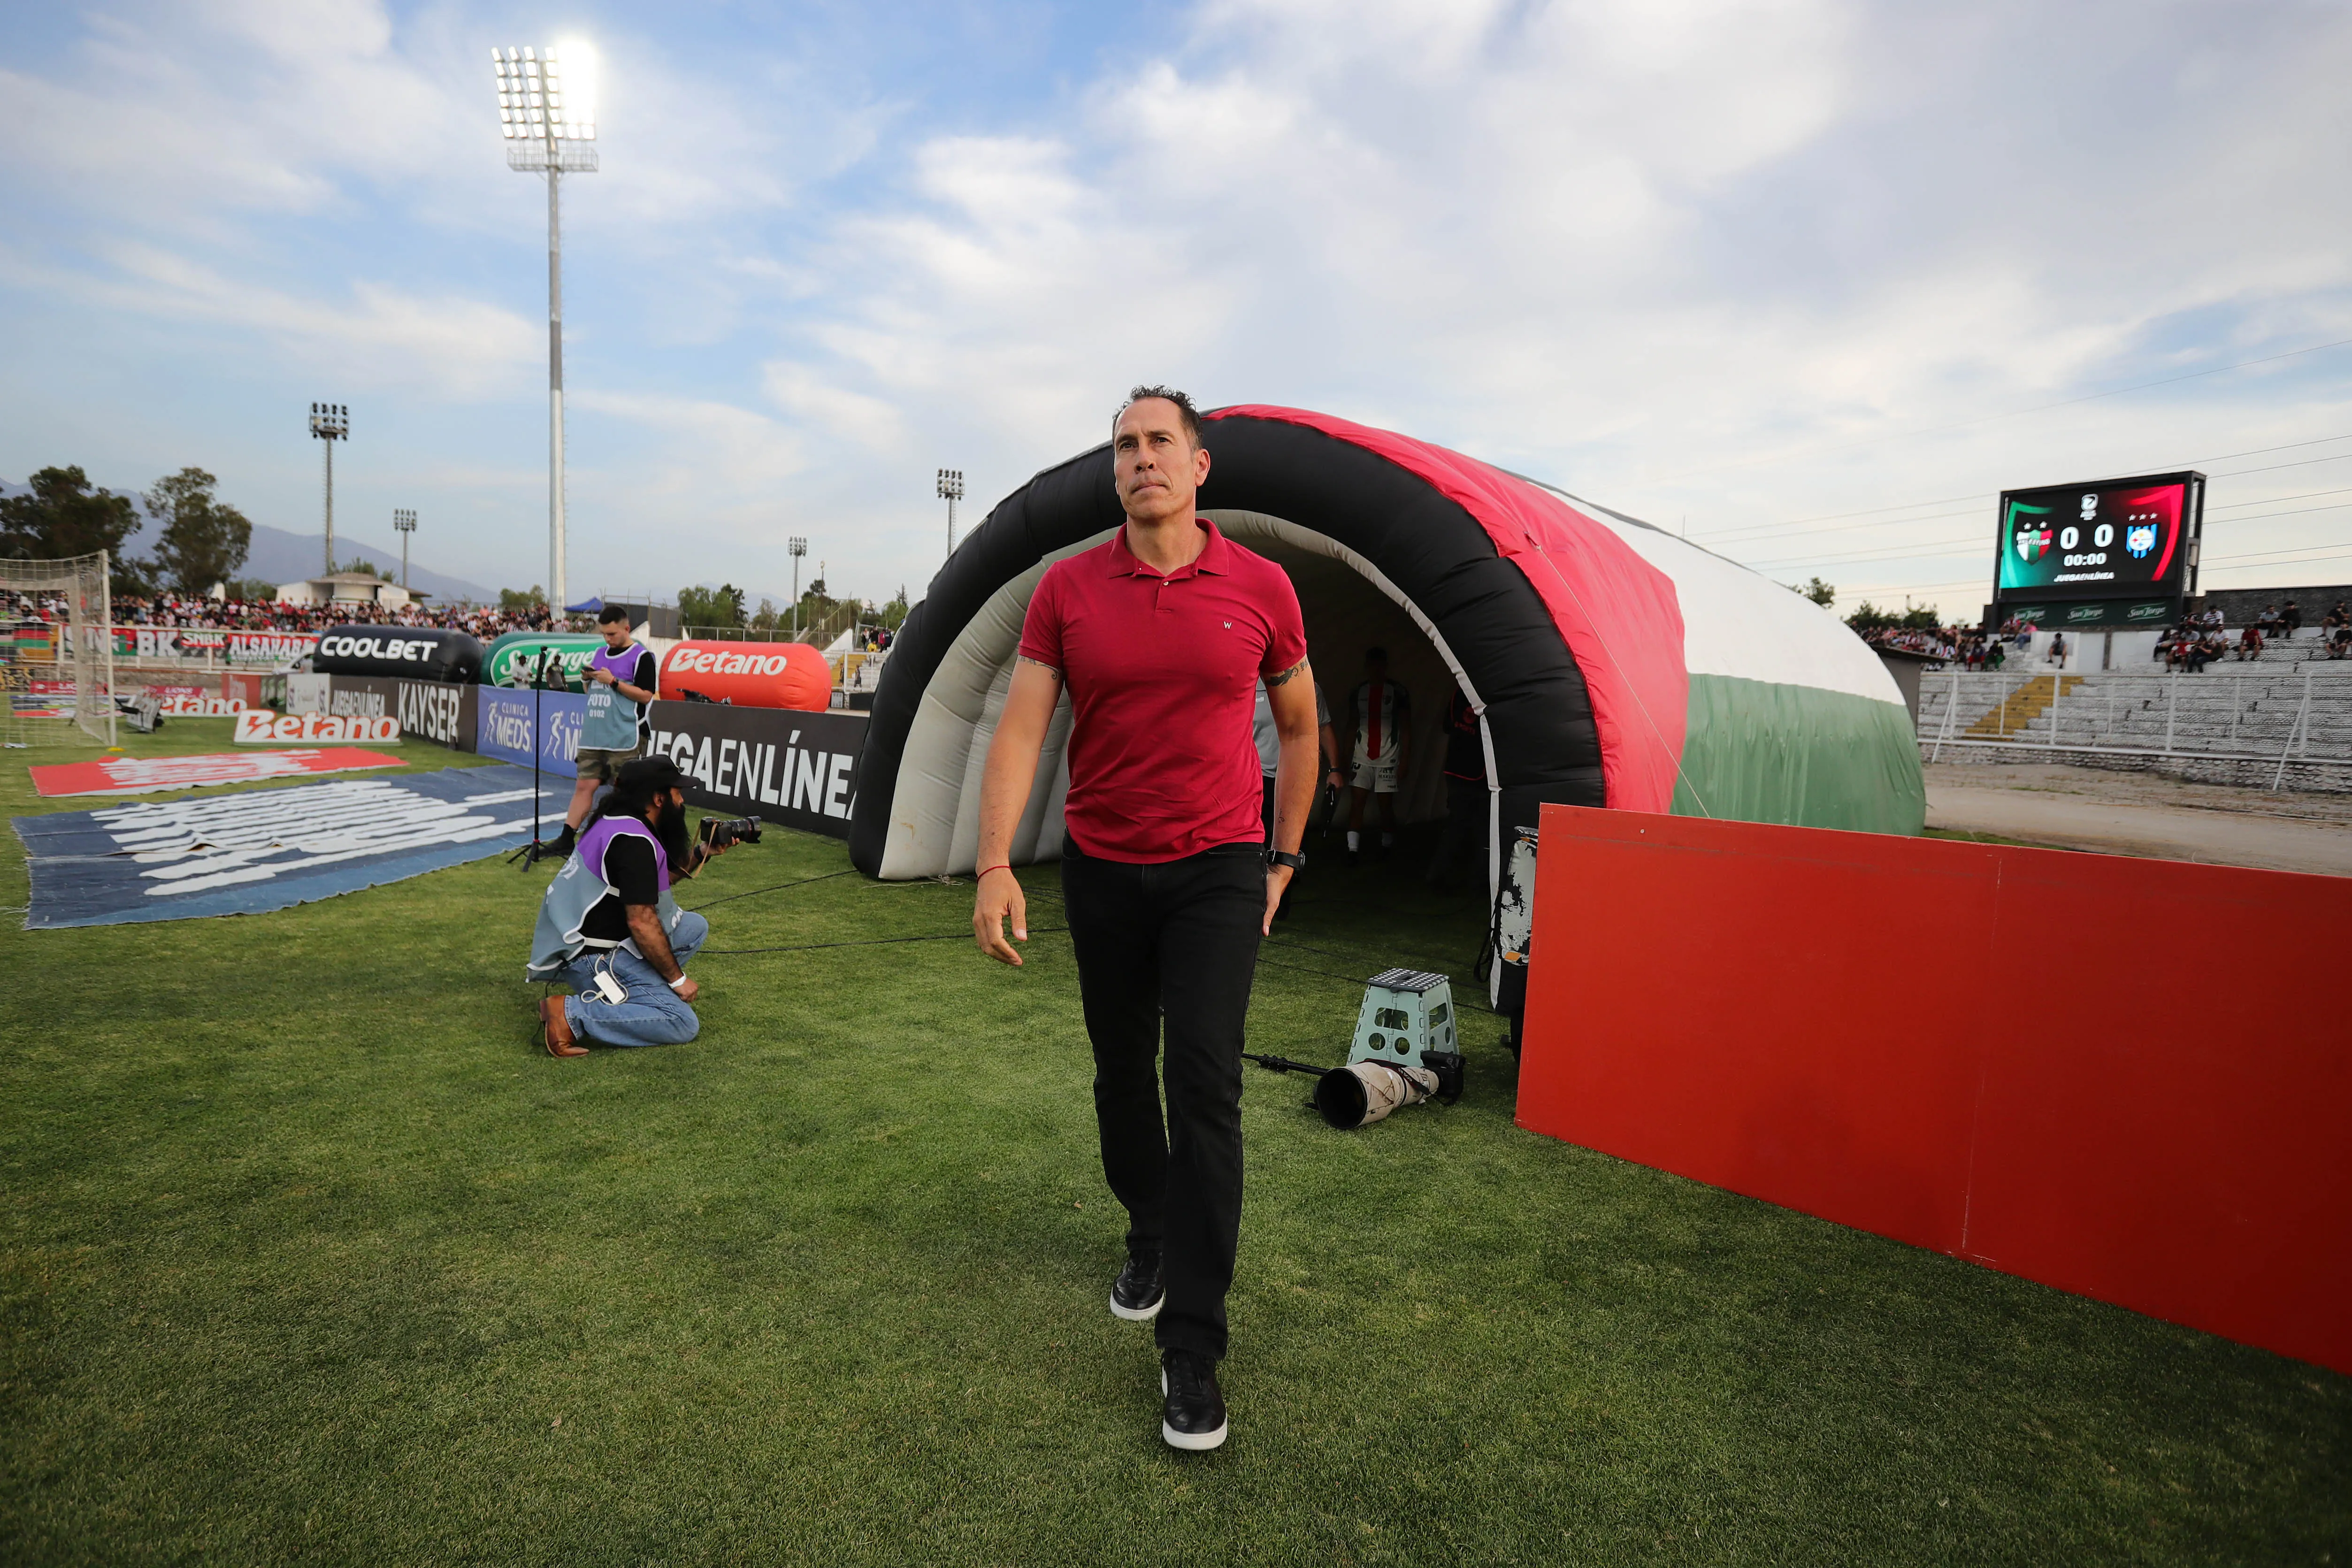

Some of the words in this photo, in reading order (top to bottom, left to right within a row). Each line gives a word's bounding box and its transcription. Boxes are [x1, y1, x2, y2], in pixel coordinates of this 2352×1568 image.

[2060, 527, 2079, 550] 0
[2094, 524, 2114, 547] 0
[2064, 552, 2107, 566] 00:00
[1224, 621, 1232, 629] W
[321, 635, 438, 662] COOLBET
[668, 648, 787, 675] Betano
[160, 694, 248, 717] etano
[588, 694, 611, 707] FOTO
[589, 709, 605, 718] 0102
[234, 710, 401, 742] Betano
[646, 730, 858, 821] EGAENLÍNE
